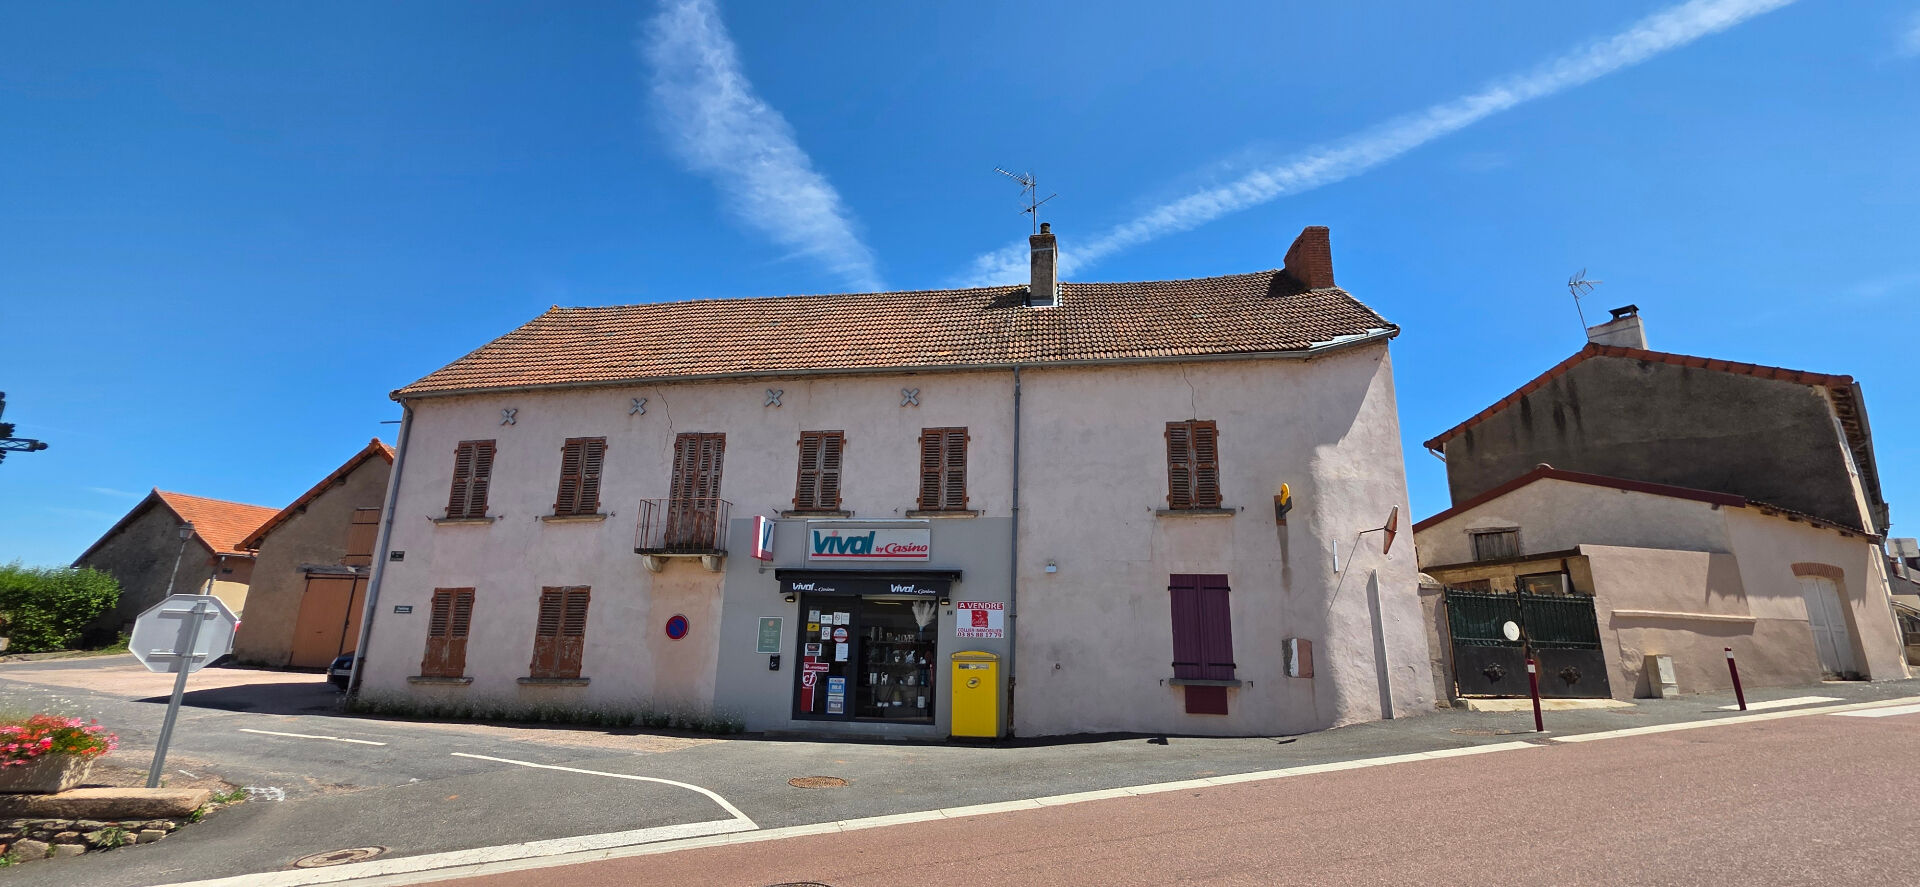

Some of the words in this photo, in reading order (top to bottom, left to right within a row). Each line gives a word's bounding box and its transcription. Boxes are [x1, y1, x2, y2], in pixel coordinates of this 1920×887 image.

[814, 530, 875, 554] Vival
[876, 545, 884, 553] by
[885, 542, 928, 554] Casino
[792, 582, 815, 591] Vival
[890, 583, 915, 593] Vival
[967, 602, 1002, 610] VENDRE
